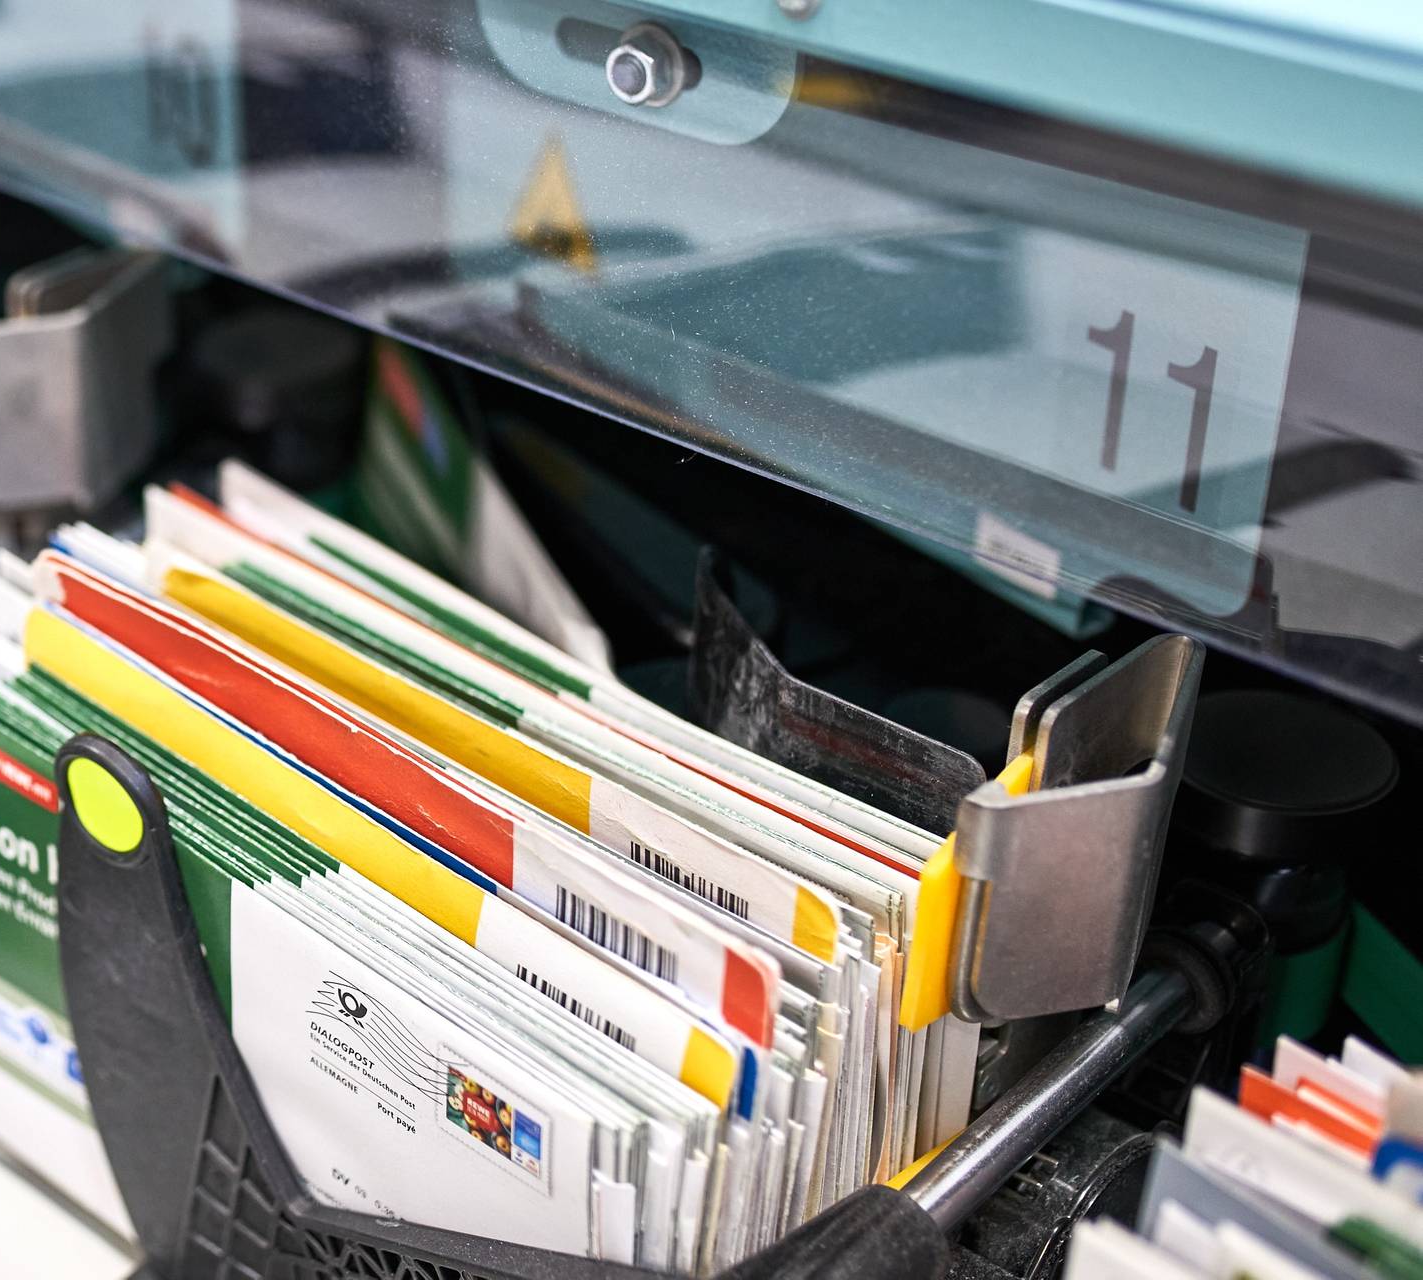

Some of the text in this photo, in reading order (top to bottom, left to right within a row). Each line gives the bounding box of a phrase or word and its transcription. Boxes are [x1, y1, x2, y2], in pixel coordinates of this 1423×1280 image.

[1087, 309, 1218, 513] 11
[310, 1021, 375, 1070] DIALOGPOST
[310, 1032, 416, 1111] Ein Service der Deutschen Post
[310, 1056, 359, 1095] ALLEMAGNE
[377, 1101, 417, 1135] Port payé
